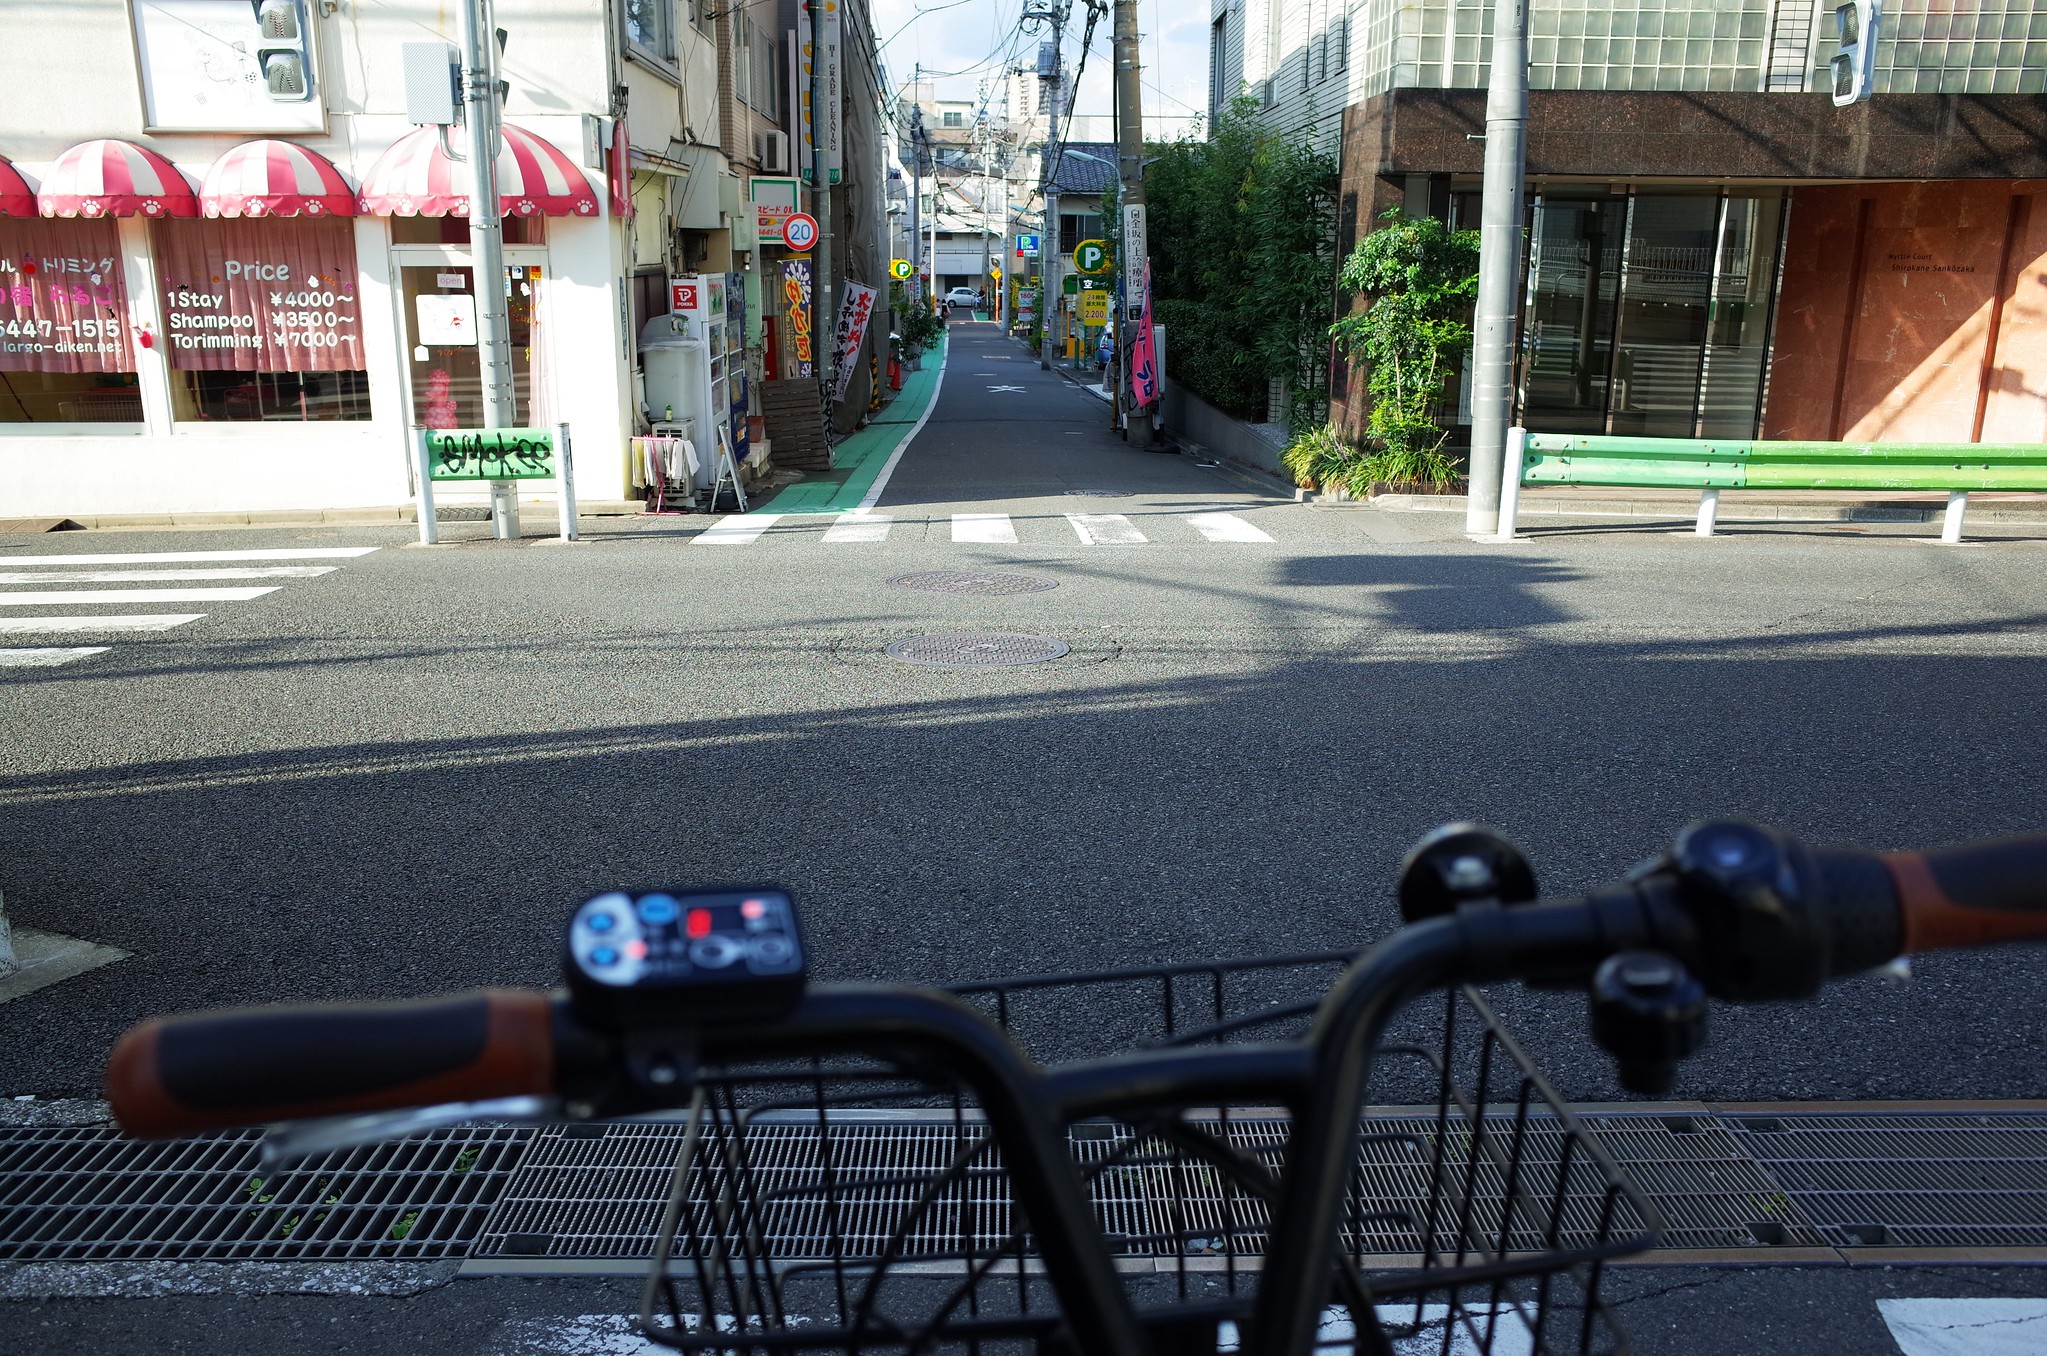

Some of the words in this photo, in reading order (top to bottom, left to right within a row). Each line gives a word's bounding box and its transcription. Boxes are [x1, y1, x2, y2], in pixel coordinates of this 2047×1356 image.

[790, 224, 810, 240] 20
[43, 256, 115, 273] トリミング
[1085, 247, 1102, 269] P
[225, 260, 290, 281] Price
[899, 263, 909, 276] P
[1891, 263, 1930, 272] Shirokane
[439, 276, 462, 286] open
[1083, 279, 1093, 289] 空
[170, 312, 254, 330] Shampoo
[3, 341, 122, 354] largo-aiken.net
[170, 333, 263, 350] Torimming
